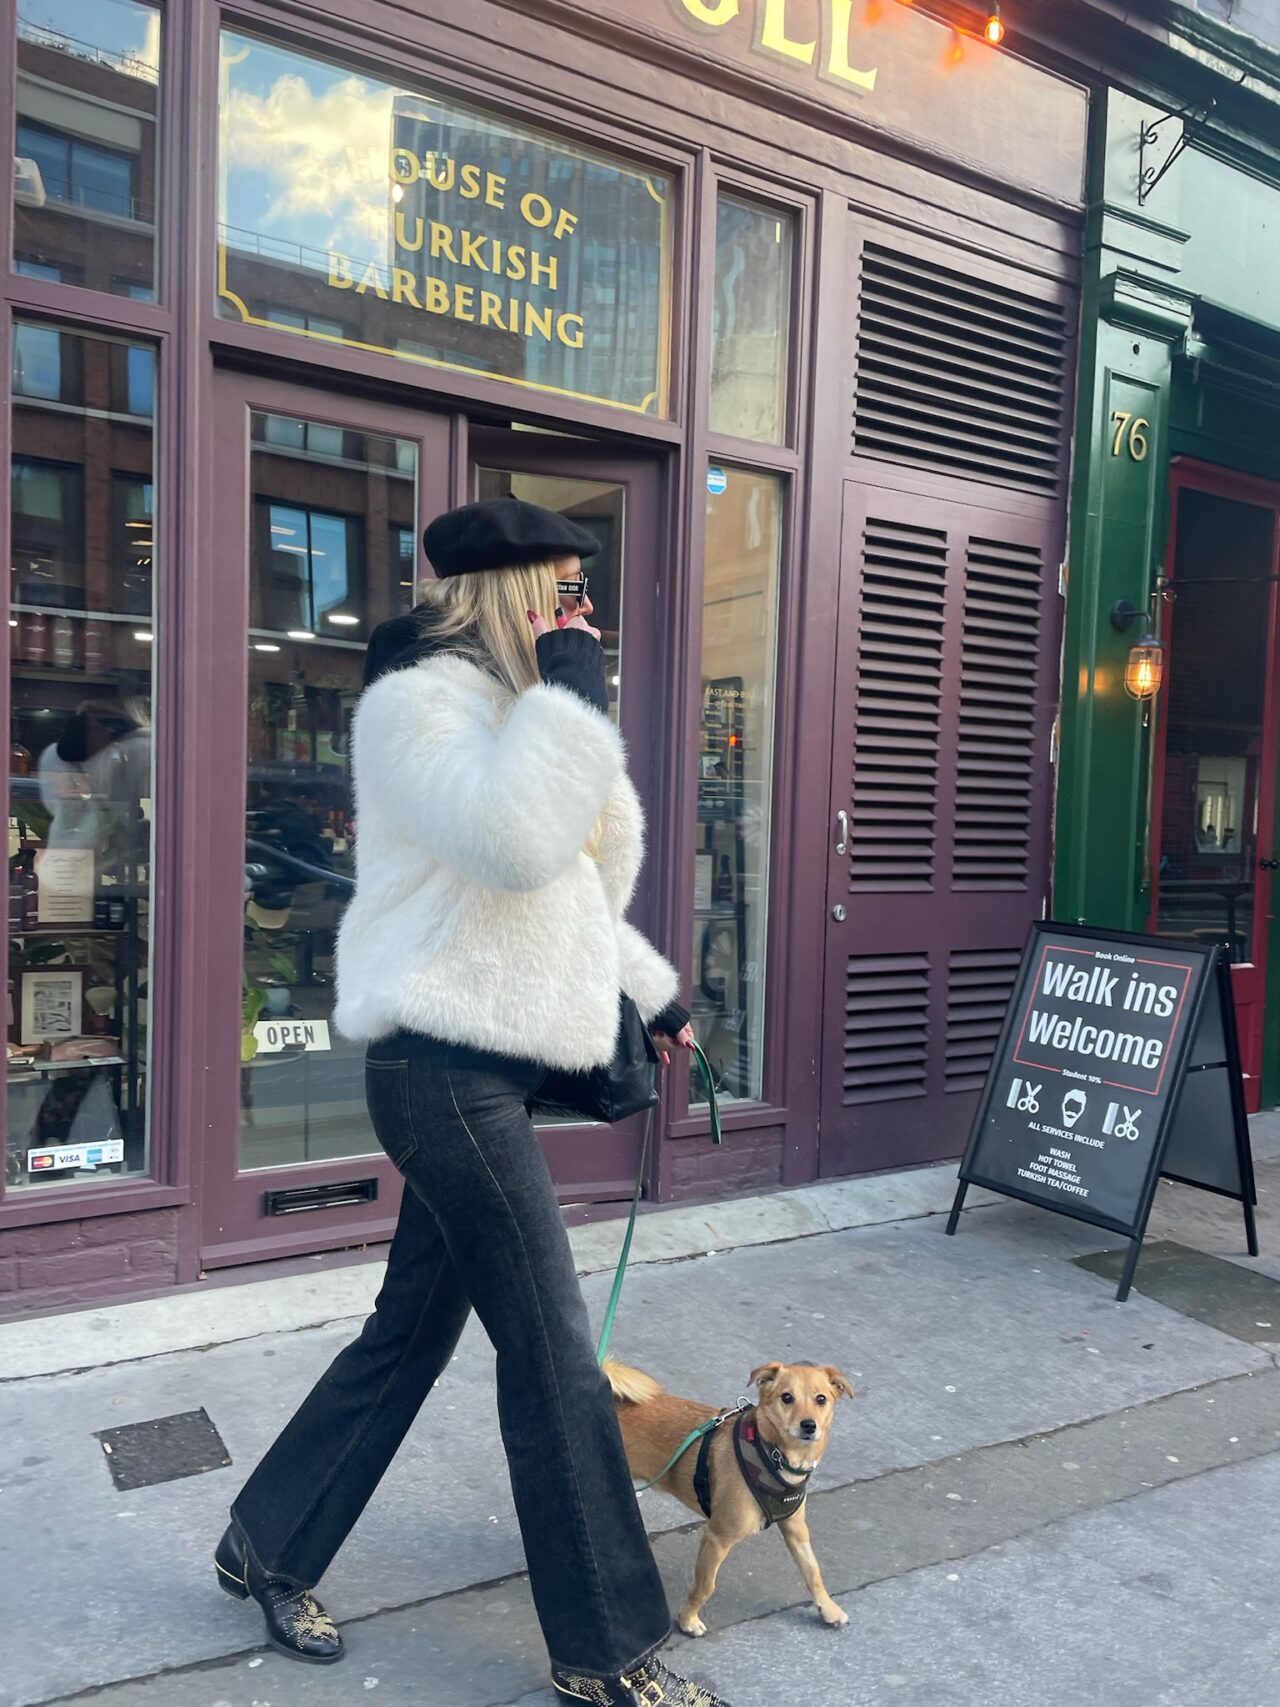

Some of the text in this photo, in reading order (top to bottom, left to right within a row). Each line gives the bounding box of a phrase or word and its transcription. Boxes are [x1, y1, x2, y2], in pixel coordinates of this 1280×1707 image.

[675, 0, 878, 93] LL
[520, 192, 578, 241] OF
[328, 250, 584, 348] BARBERING
[1112, 411, 1149, 462] 76
[1095, 951, 1135, 963] Book Online
[1043, 961, 1178, 1017] Walk ins
[267, 1026, 315, 1045] OPEN
[1028, 1010, 1163, 1069] Welcome
[1062, 1069, 1102, 1084] Student 10%
[1028, 1121, 1105, 1149] ALL SERVICES INCLUDE
[59, 1155, 80, 1163] VISA
[1038, 1154, 1077, 1173] HOT TOWEL
[1050, 1147, 1071, 1160] WASH
[1017, 1168, 1090, 1197] TURKISH TEA/COFFEE
[1029, 1162, 1082, 1184] FOOT MASSAGE
